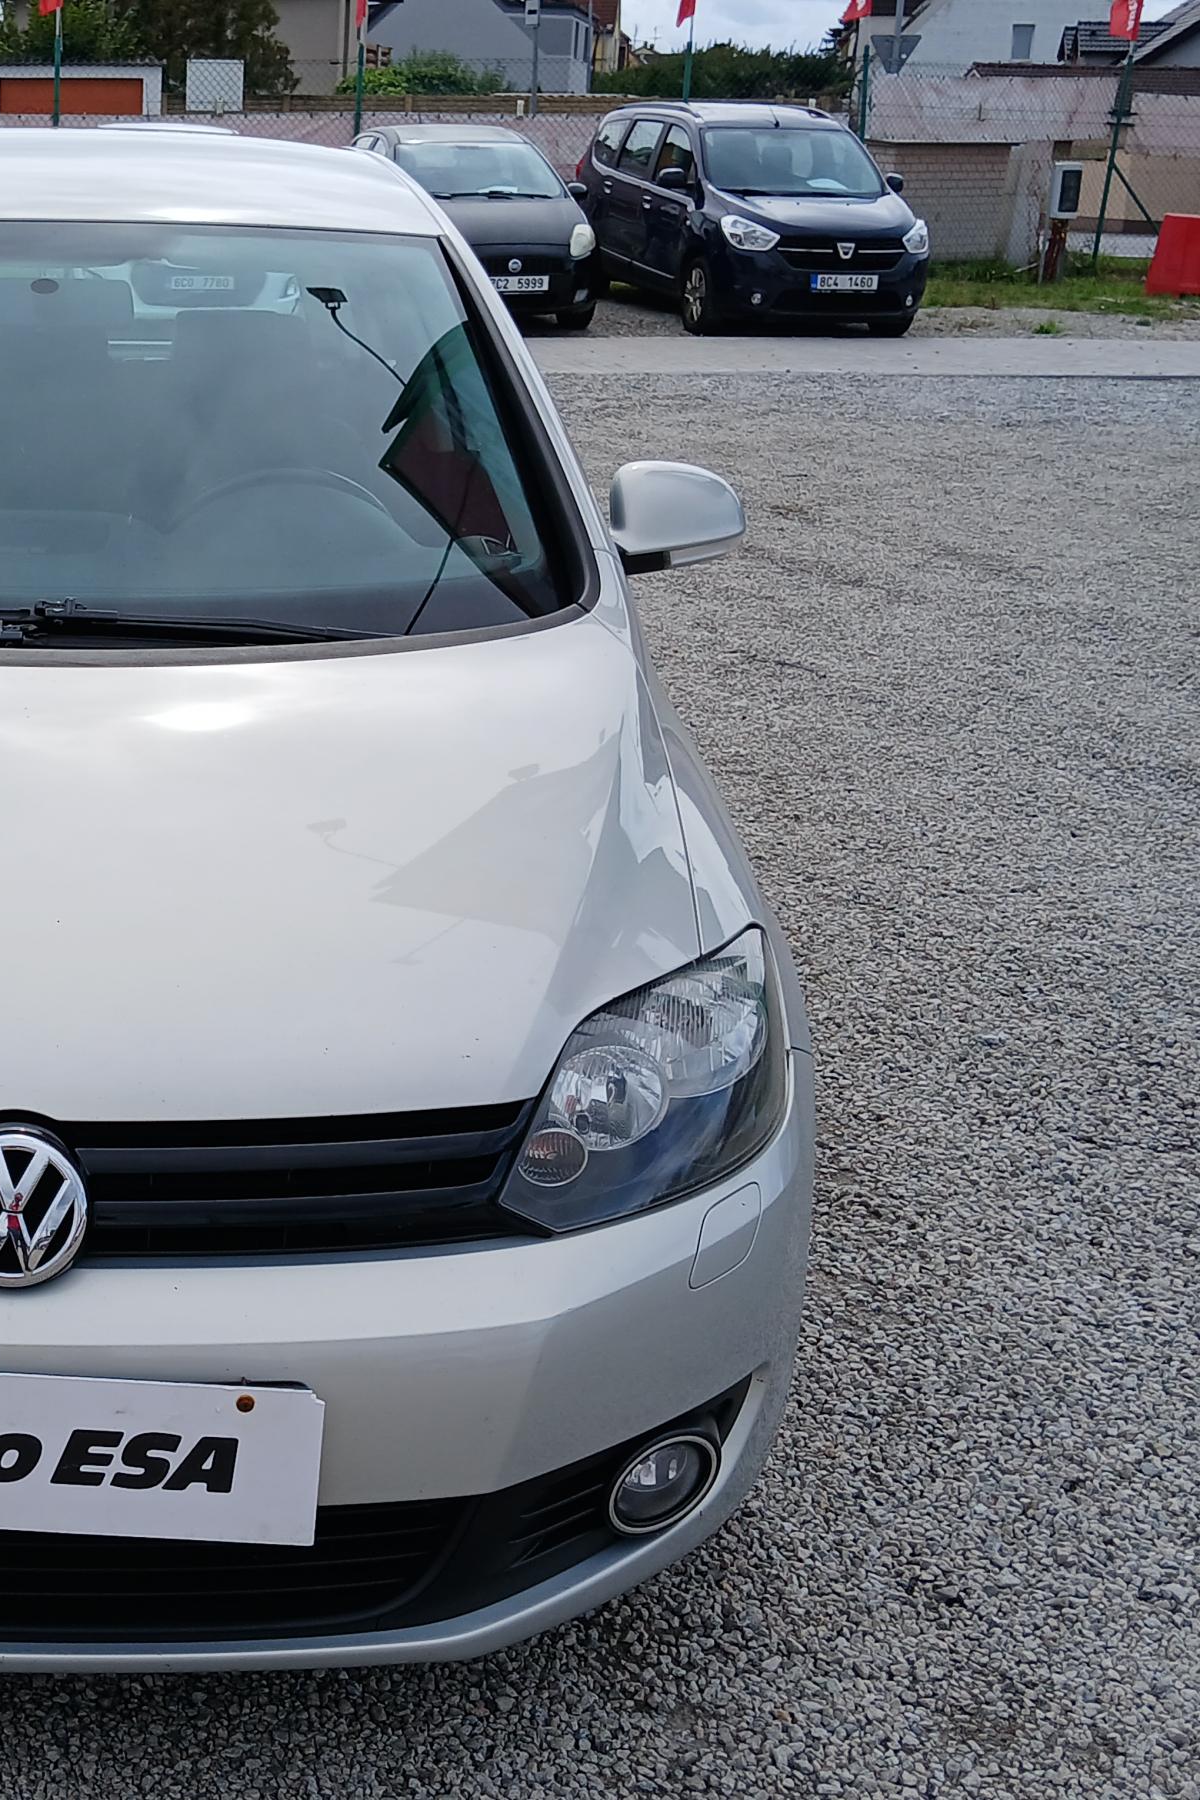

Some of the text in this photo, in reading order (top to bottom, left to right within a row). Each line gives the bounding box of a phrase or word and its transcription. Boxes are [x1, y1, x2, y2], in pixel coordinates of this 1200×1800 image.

[517, 277, 545, 290] 5999
[819, 275, 874, 289] 8C4 1460
[49, 1428, 240, 1494] ESA
